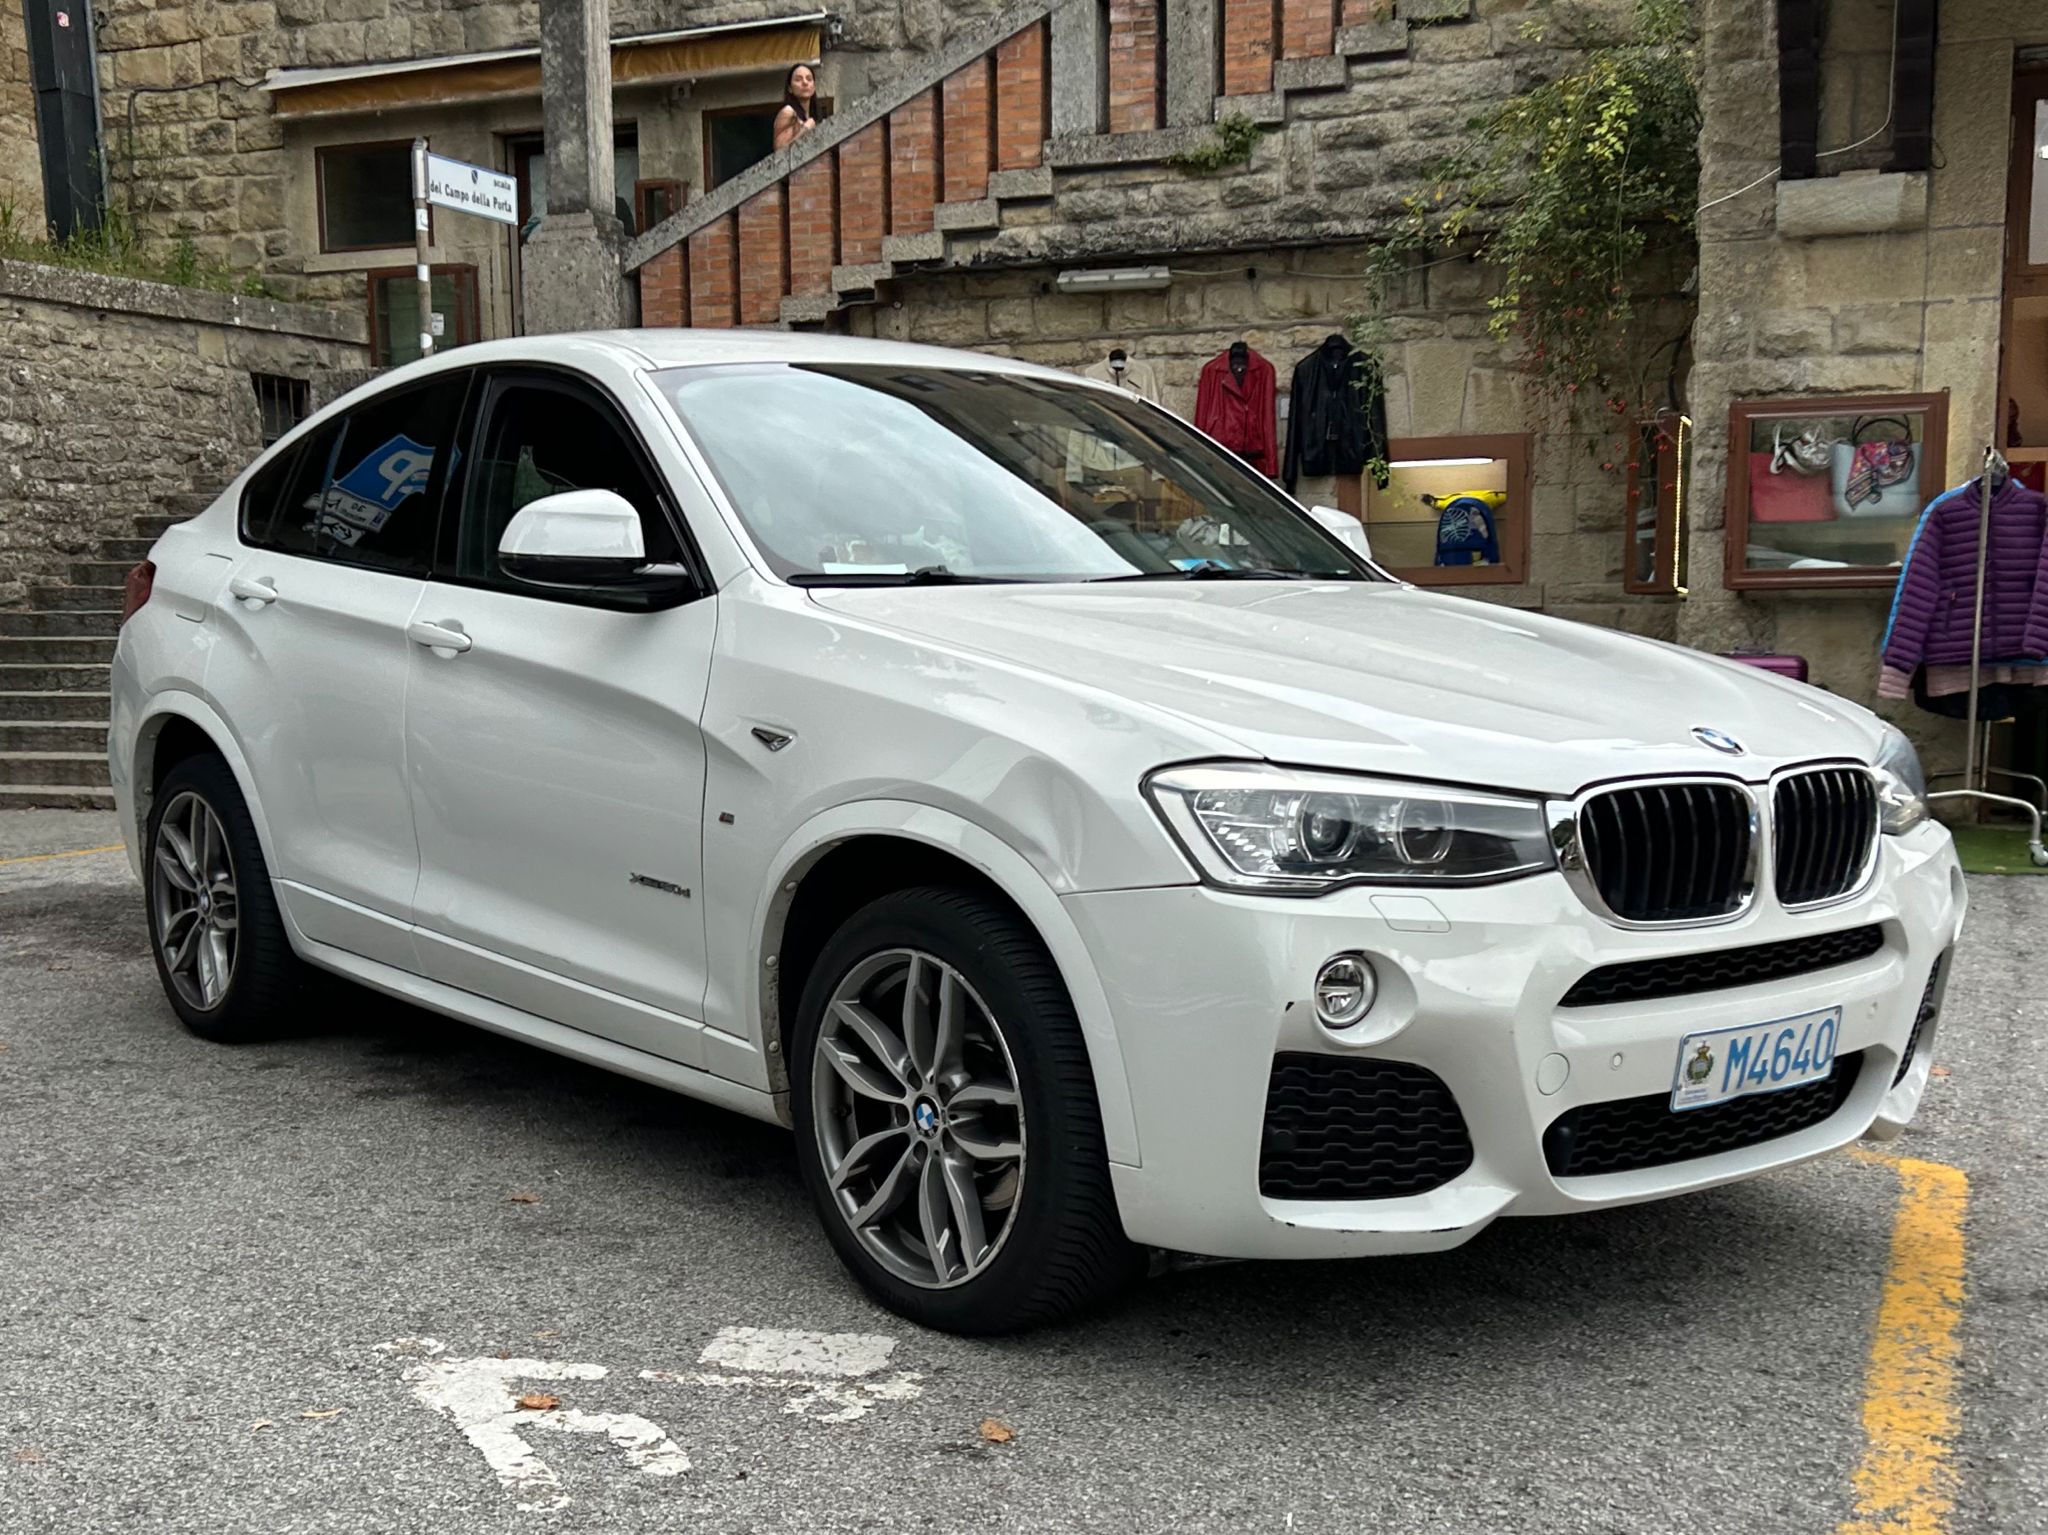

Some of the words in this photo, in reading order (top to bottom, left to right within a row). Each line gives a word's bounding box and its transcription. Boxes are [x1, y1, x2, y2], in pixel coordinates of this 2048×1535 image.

[430, 181, 442, 195] del
[444, 184, 470, 203] Campo
[472, 191, 490, 207] della
[493, 197, 513, 213] Porta
[493, 178, 512, 191] scala
[1721, 1018, 1835, 1093] M4640
